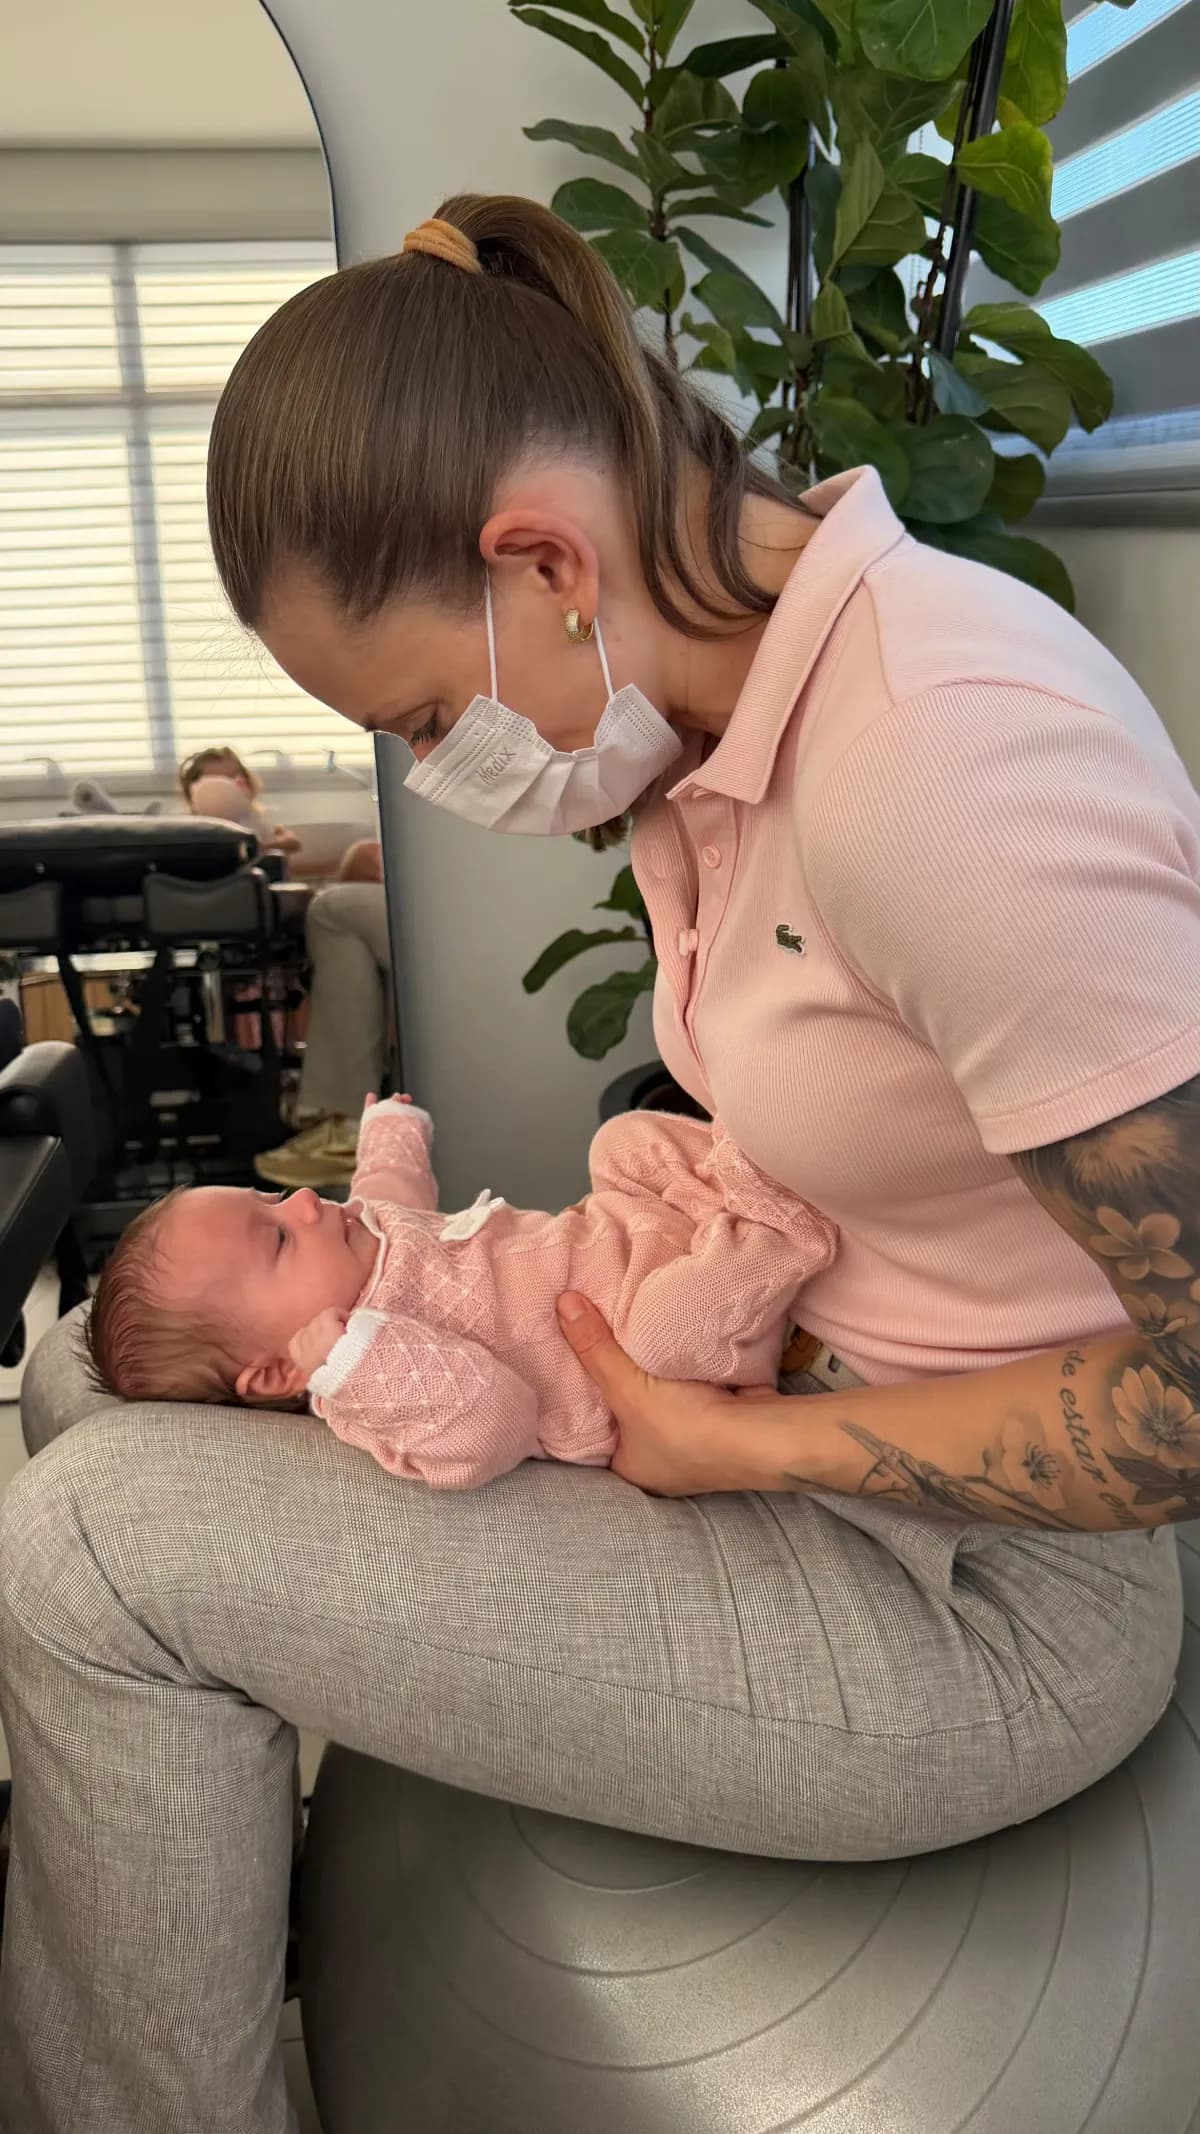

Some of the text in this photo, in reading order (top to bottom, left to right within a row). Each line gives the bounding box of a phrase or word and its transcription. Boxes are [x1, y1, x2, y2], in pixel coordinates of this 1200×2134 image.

[474, 746, 517, 785] Medix
[1062, 1350, 1086, 1377] de
[1060, 1388, 1107, 1484] estar
